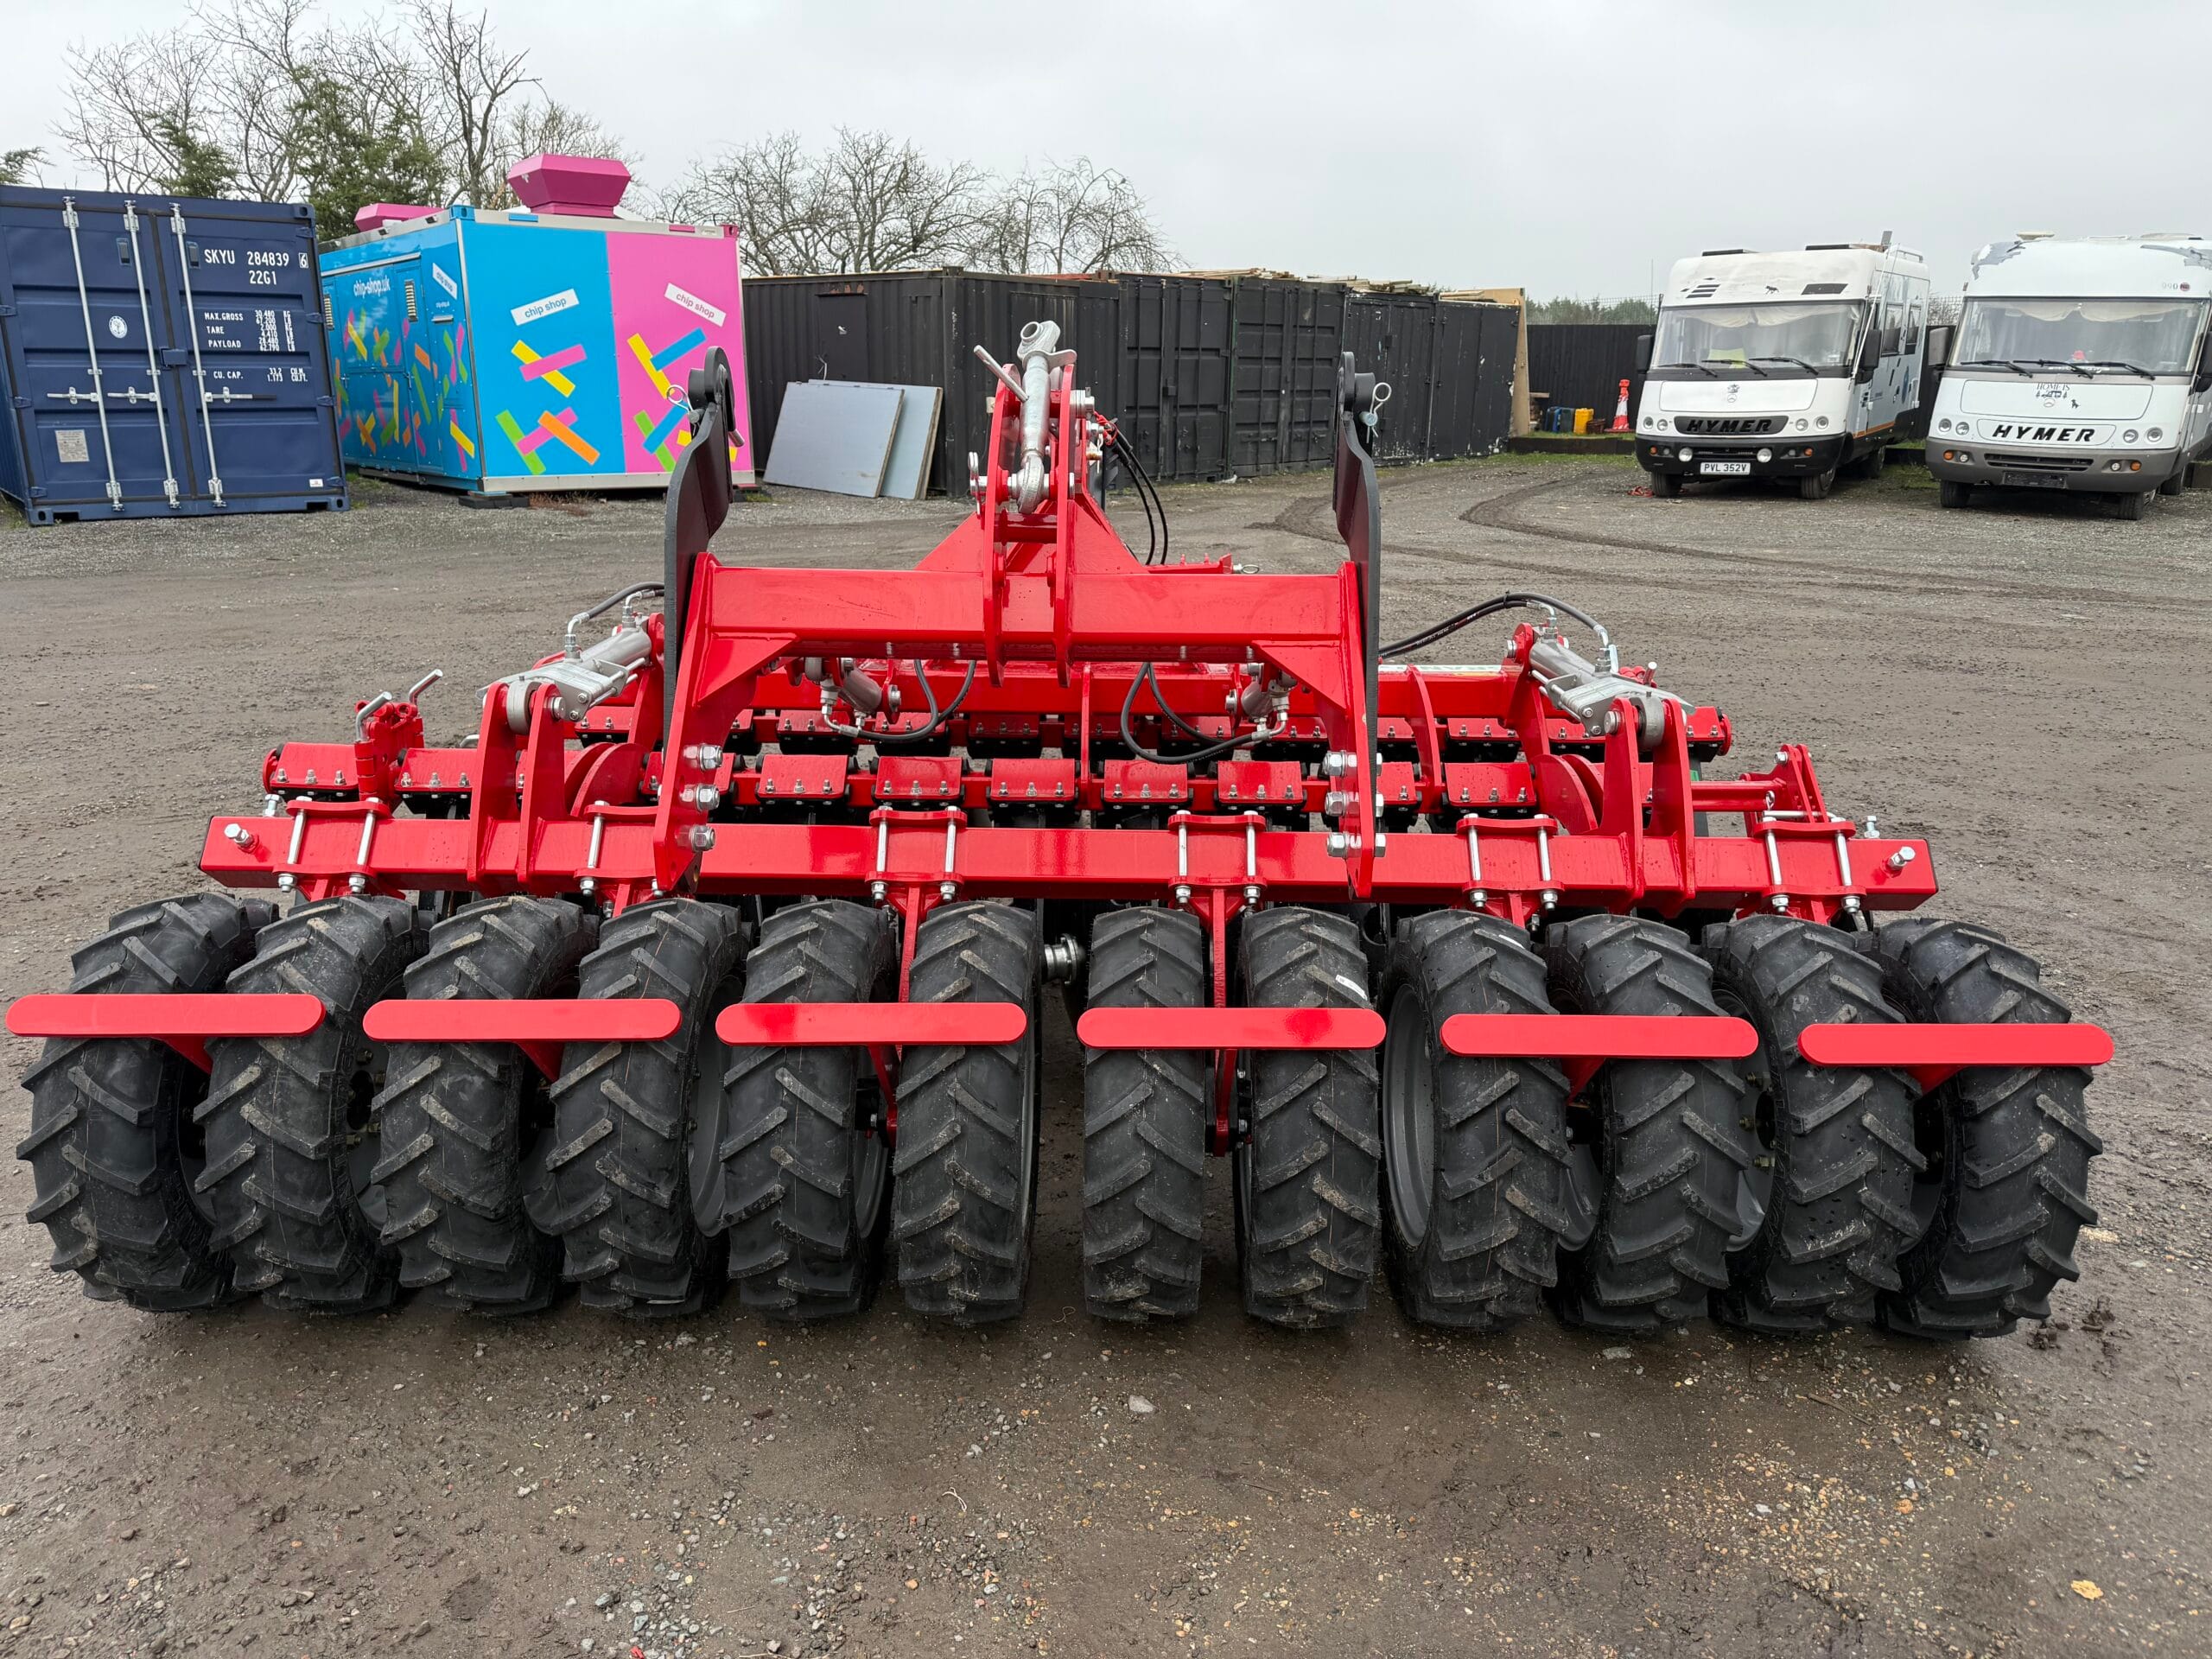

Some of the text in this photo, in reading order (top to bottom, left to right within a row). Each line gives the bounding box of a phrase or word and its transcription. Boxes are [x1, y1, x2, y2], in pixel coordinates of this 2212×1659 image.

[204, 249, 308, 268] SKYU 284839 6
[249, 270, 276, 285] 22G1
[353, 275, 391, 298] chip-shop.uk
[524, 297, 567, 318] chip shop
[676, 293, 715, 318] chip shop
[204, 312, 244, 321] MAX.GROSS
[207, 326, 225, 334] TARE
[208, 340, 241, 348] PAYLOAD
[227, 371, 244, 379] CAP.
[1686, 419, 1772, 432] HYMER
[1992, 424, 2095, 442] HYMER
[1723, 463, 1746, 472] 352V
